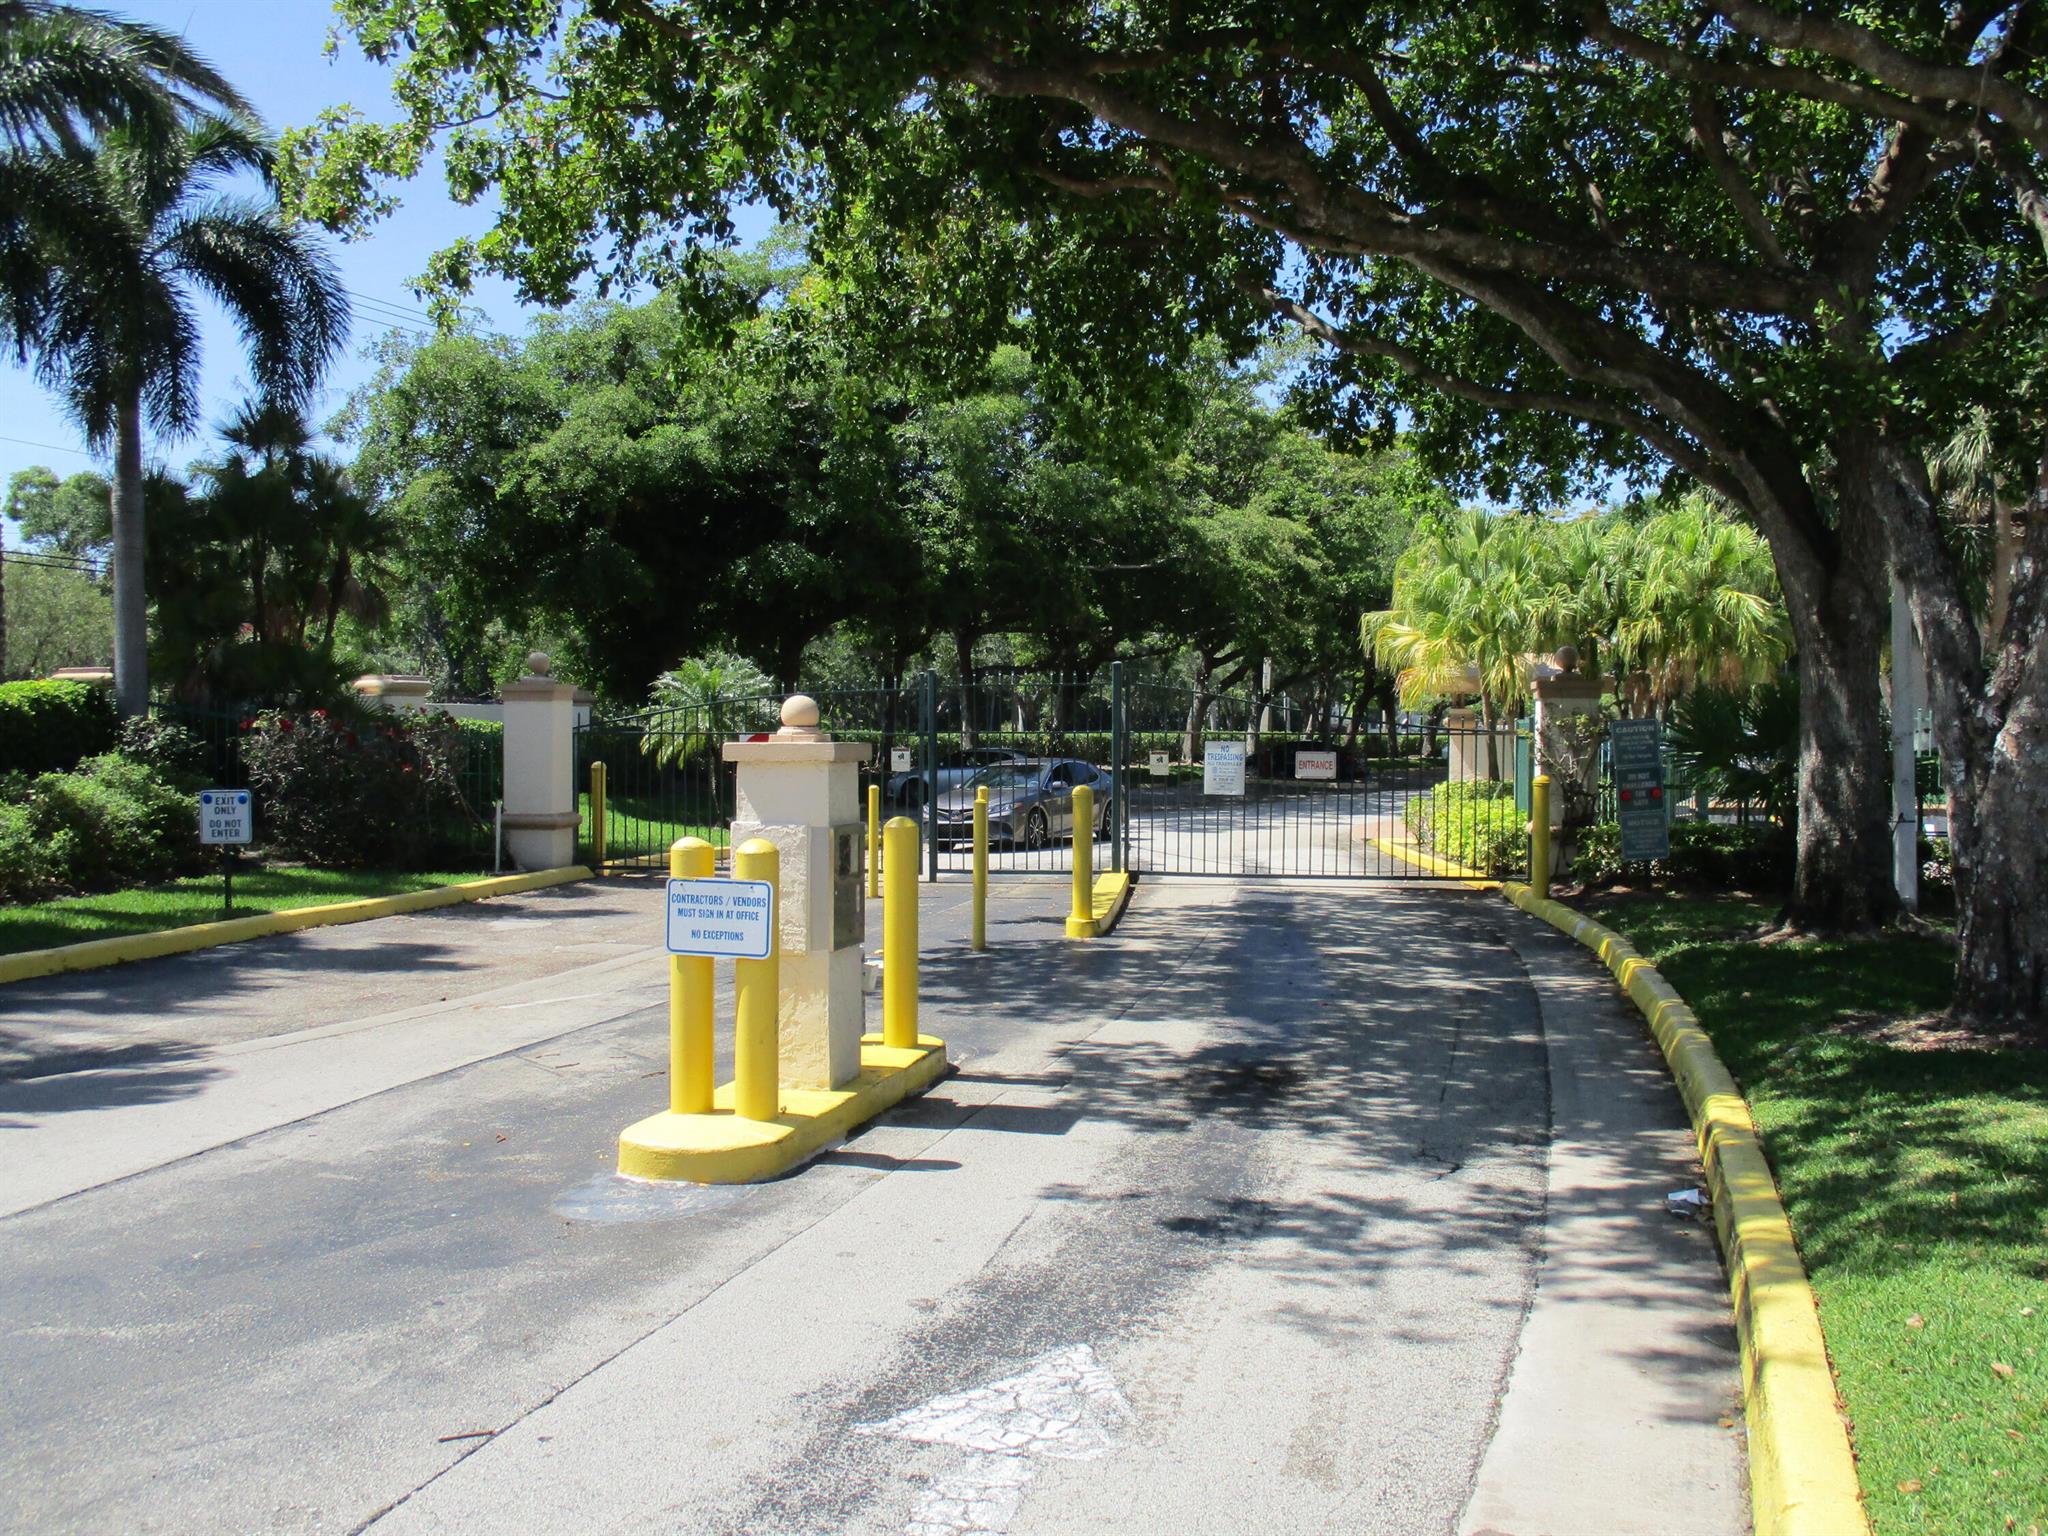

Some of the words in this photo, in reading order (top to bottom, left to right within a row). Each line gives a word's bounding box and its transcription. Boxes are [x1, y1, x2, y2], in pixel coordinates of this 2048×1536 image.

[1616, 726, 1654, 734] CAUTION
[1220, 744, 1230, 752] NO
[1207, 753, 1243, 761] TRESPASSING
[1299, 760, 1333, 770] ENTRANCE
[215, 797, 235, 805] EXIT
[214, 807, 236, 815] ONLY
[209, 820, 221, 828] DO
[224, 819, 242, 828] NOT
[211, 829, 240, 838] ENTER
[672, 893, 723, 906] CONTRACTORS
[726, 896, 730, 906] /
[733, 896, 766, 907] VENDORS
[677, 908, 696, 917] MUST
[698, 908, 714, 918] SIGN
[716, 909, 723, 919] IN
[726, 910, 734, 919] AT
[736, 911, 759, 921] OFFICE
[691, 929, 701, 939] NO
[703, 930, 744, 941] EXCEPTIONS
